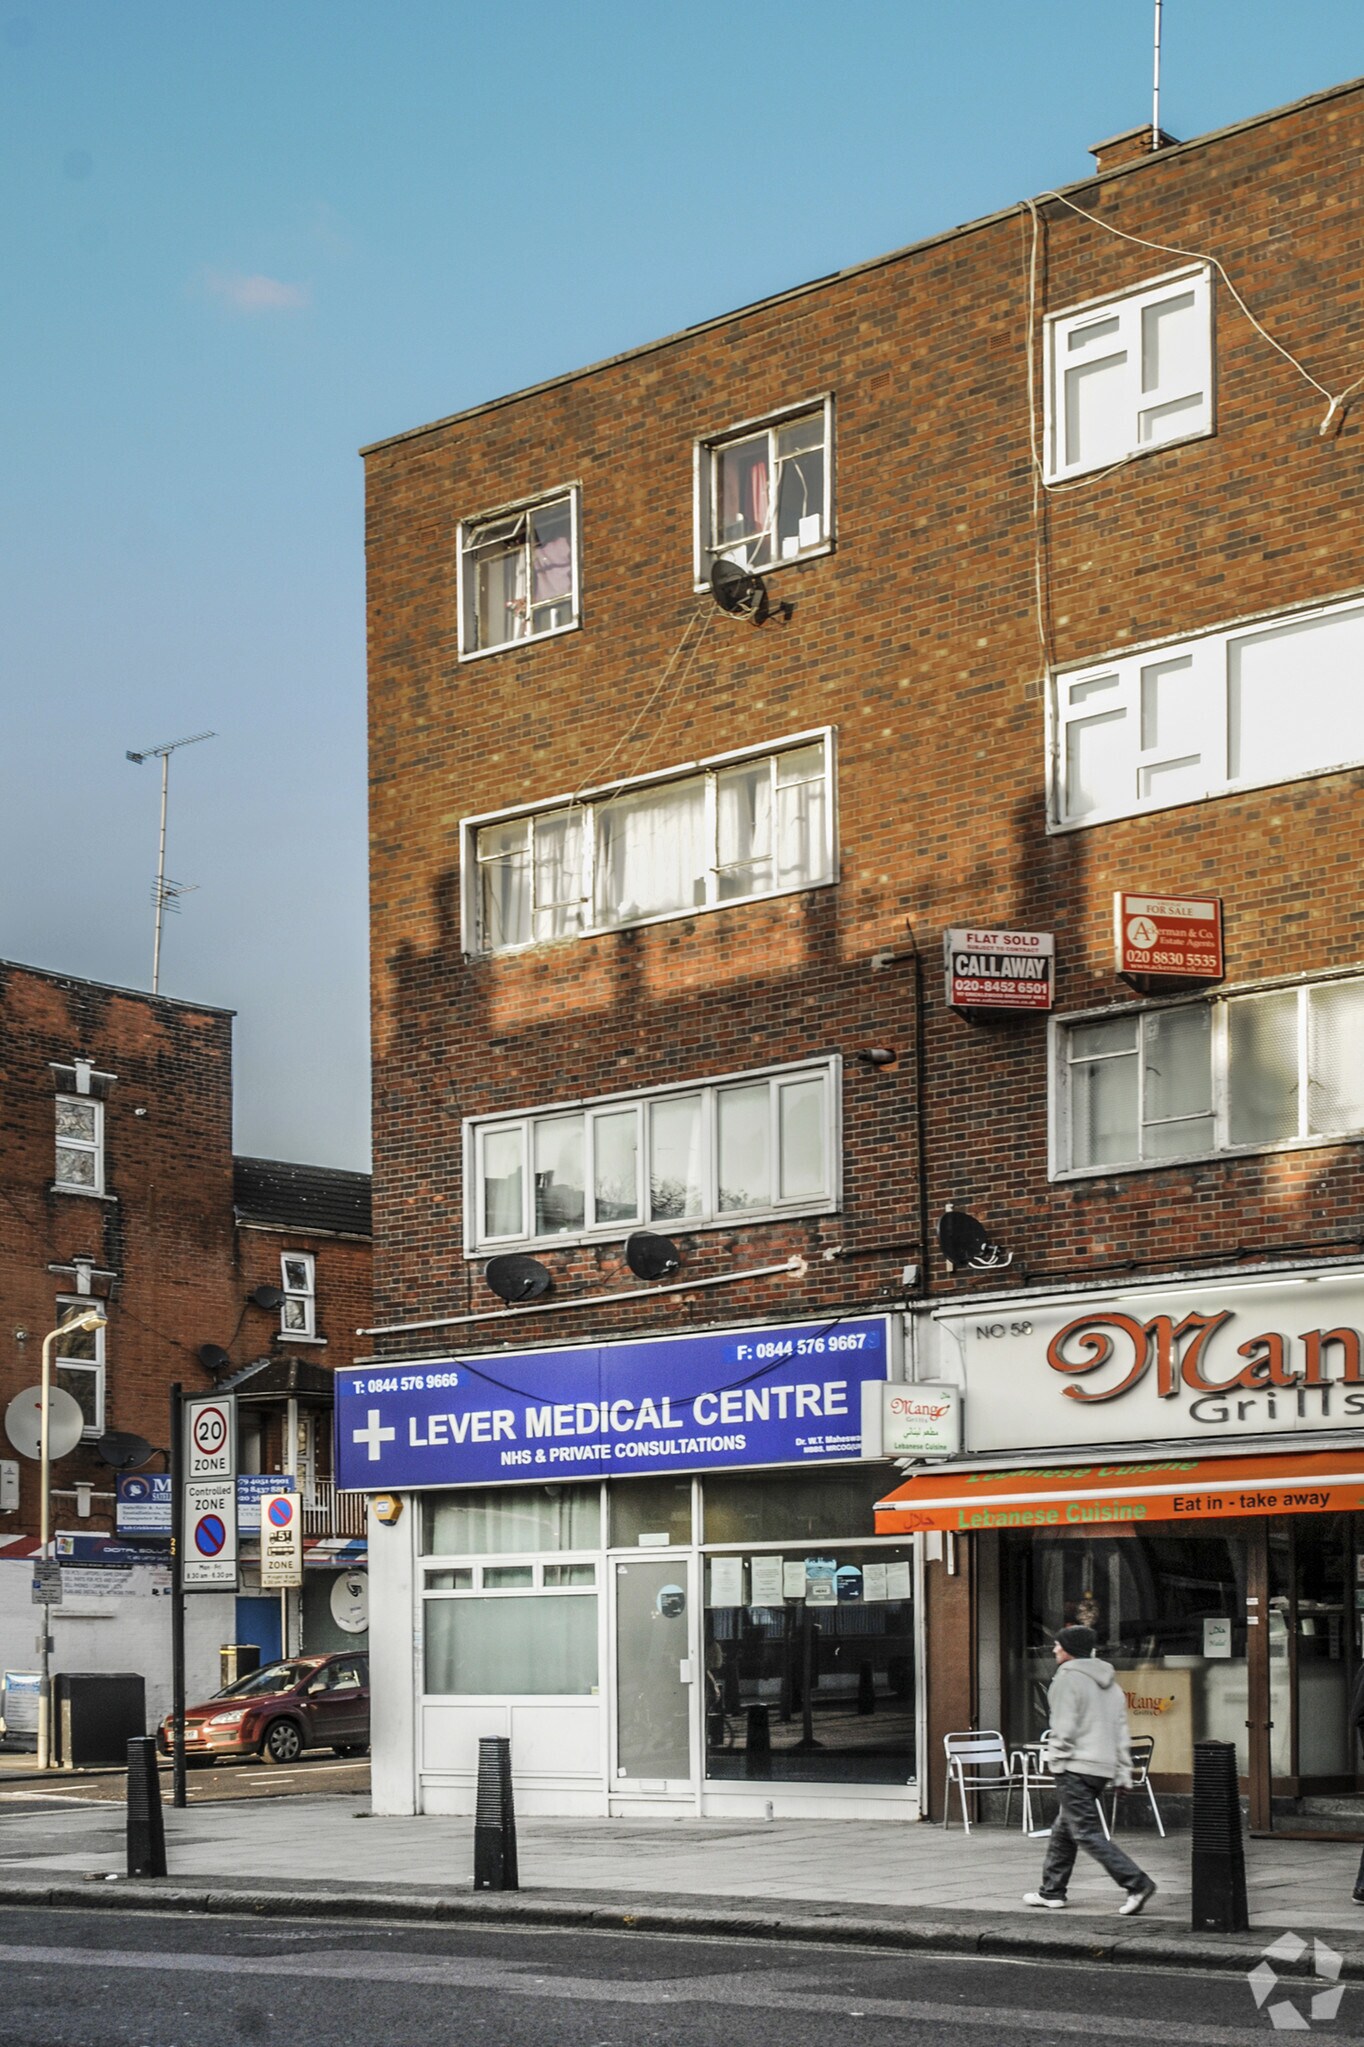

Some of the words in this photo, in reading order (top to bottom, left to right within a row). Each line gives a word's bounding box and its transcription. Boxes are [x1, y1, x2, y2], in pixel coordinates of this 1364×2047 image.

[1146, 904, 1166, 914] FOR
[1168, 906, 1193, 916] SALE
[966, 933, 998, 944] FLAT
[1004, 935, 1040, 946] SOLD
[1133, 921, 1187, 941] Ackerman
[1188, 928, 1197, 938] &
[1198, 929, 1214, 939] Co.
[1160, 936, 1184, 946] Estate
[1186, 939, 1216, 948] Agents
[955, 954, 1046, 979] CALLAWAY
[1126, 950, 1150, 964] 020
[1152, 952, 1184, 966] 8830
[1186, 954, 1217, 967] 5535
[955, 980, 1016, 993] 020-8452
[1018, 982, 1048, 994] 6501
[976, 1323, 1006, 1340] NO
[1010, 1320, 1033, 1337] 58
[736, 1344, 752, 1360] F:
[756, 1340, 794, 1358] 0844
[796, 1338, 826, 1354] 576
[828, 1333, 866, 1352] 9667
[1046, 1309, 1364, 1402] Man
[352, 1380, 365, 1394] T:
[368, 1378, 398, 1393] 0844
[400, 1376, 424, 1390] 576
[426, 1372, 458, 1388] 9666
[408, 1409, 517, 1447] LEVER
[525, 1396, 684, 1439] MEDICAL
[692, 1380, 848, 1427] CENTRE
[1189, 1387, 1364, 1424] Grills
[199, 1421, 222, 1440] 20
[500, 1449, 532, 1466] NHS
[534, 1448, 546, 1464] &
[550, 1443, 612, 1462] PRIVATE
[614, 1434, 747, 1458] CONSULTATIONS
[795, 1438, 807, 1446] Dr.
[894, 1442, 923, 1450] Lebanese
[194, 1458, 226, 1471] ZONE
[1098, 1462, 1199, 1478] Cuisine
[153, 1478, 172, 1492] M
[189, 1486, 232, 1496] Controlled
[195, 1498, 226, 1511] ZONE
[1173, 1496, 1201, 1512] Eat
[1206, 1496, 1222, 1510] in
[1240, 1493, 1277, 1508] take
[1283, 1492, 1330, 1508] away
[958, 1507, 1059, 1529] Lebanese
[1066, 1501, 1147, 1523] Cuisine
[268, 1560, 294, 1569] ZONE
